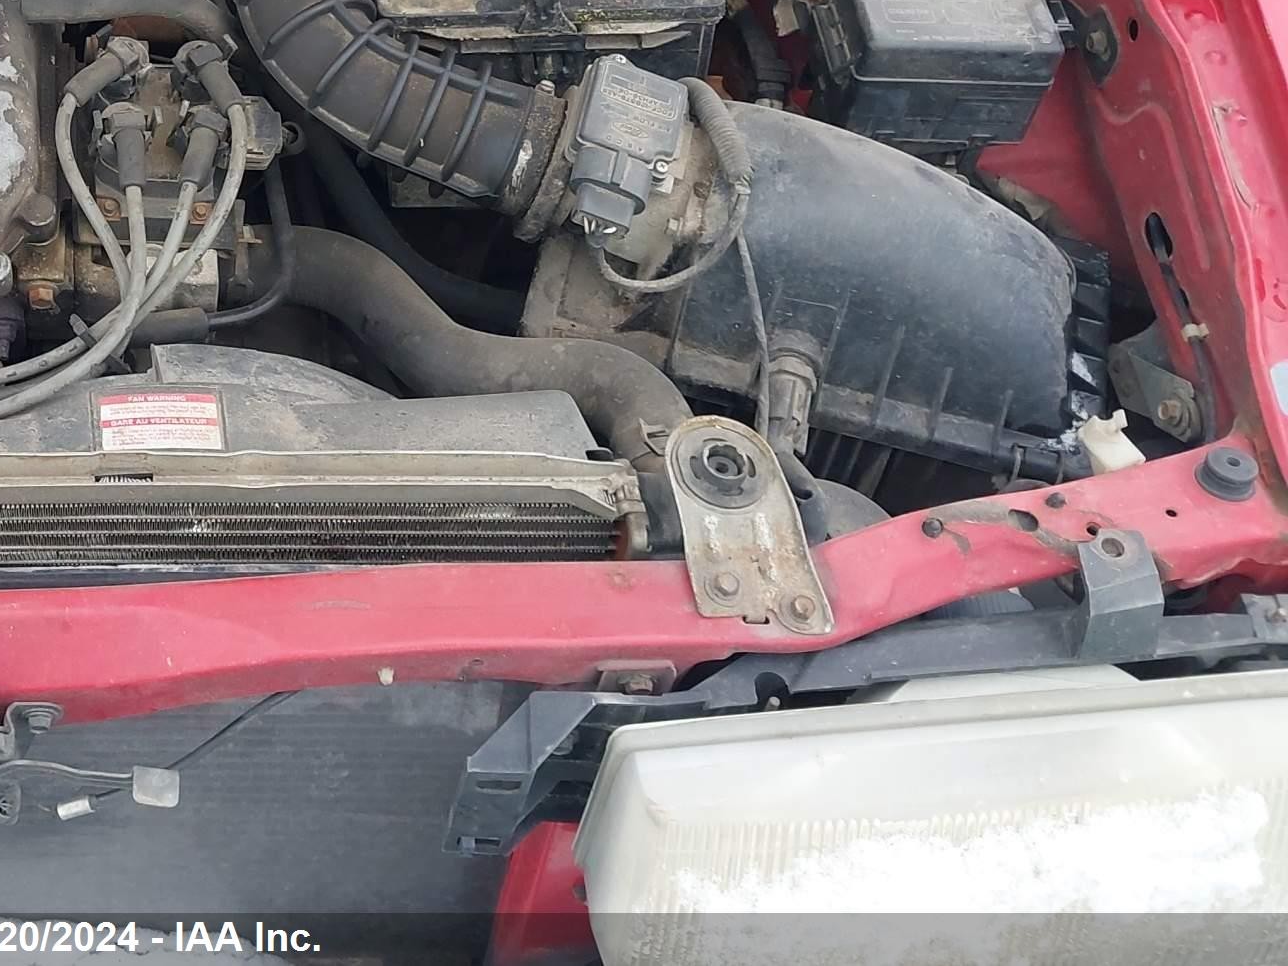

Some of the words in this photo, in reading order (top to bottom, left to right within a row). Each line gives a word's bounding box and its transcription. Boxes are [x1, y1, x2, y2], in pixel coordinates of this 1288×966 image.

[128, 395, 145, 403] FAN
[147, 394, 187, 402] WARNING
[136, 418, 149, 426] AU
[150, 416, 208, 425] VENTILATEUR
